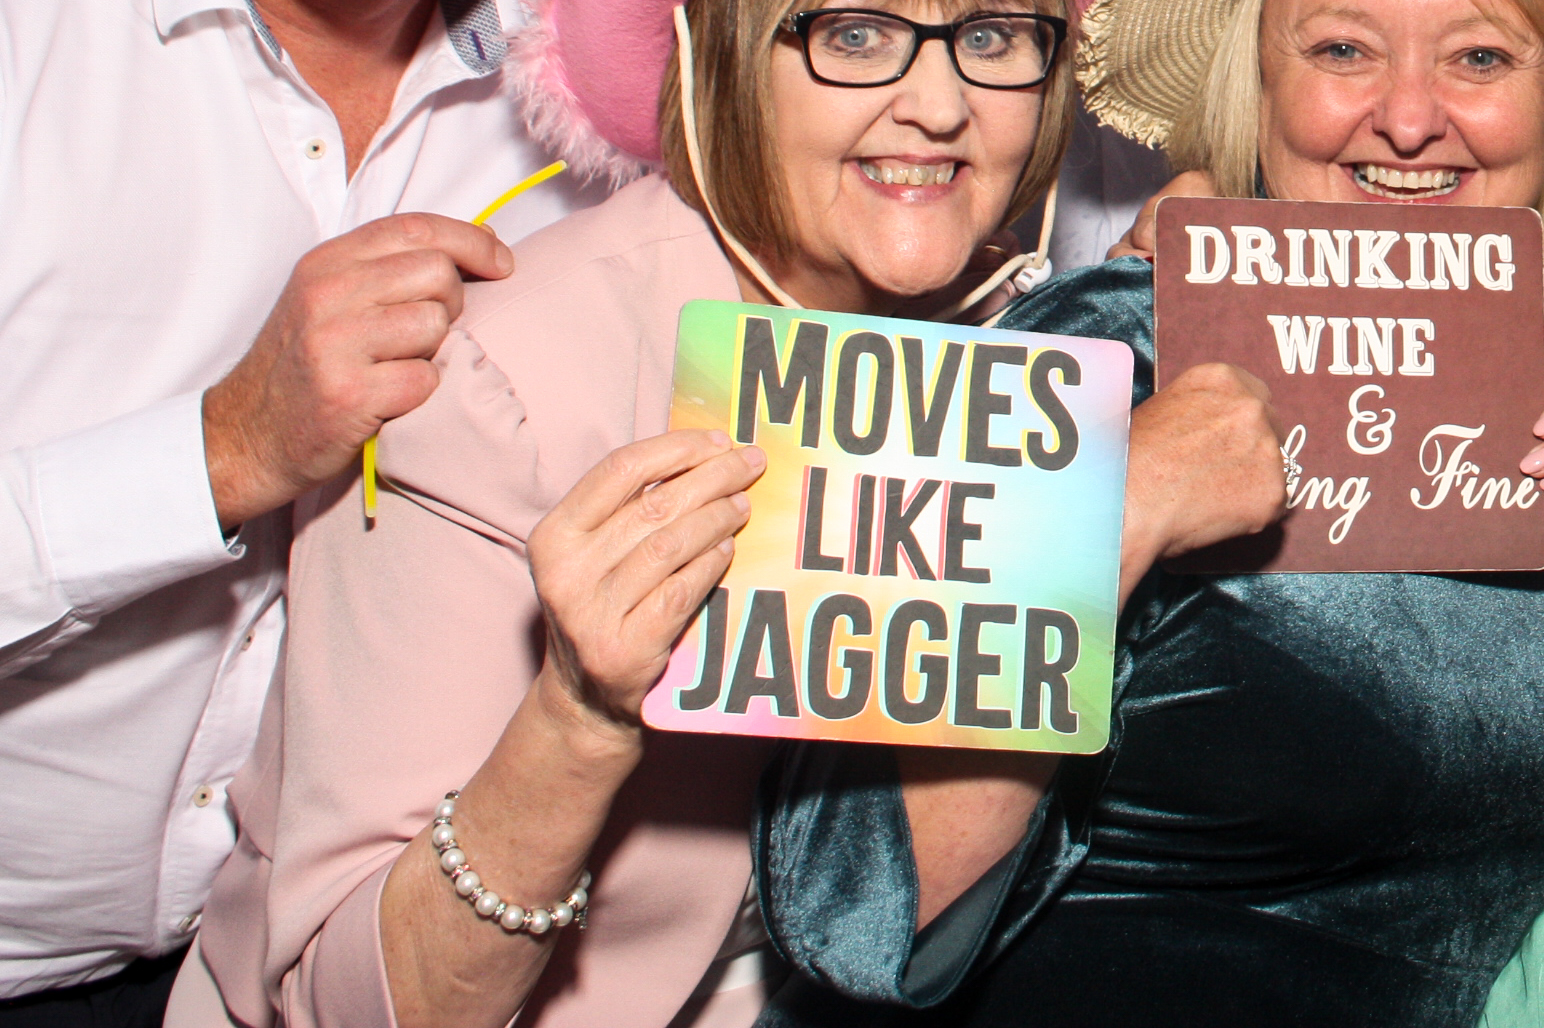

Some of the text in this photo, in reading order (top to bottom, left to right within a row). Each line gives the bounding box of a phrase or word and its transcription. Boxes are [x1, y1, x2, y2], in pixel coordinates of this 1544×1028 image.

[1185, 225, 1516, 291] DRINKING
[1267, 314, 1435, 377] WINE
[730, 313, 1082, 471] MOVES
[1347, 384, 1396, 455] &
[1410, 424, 1540, 510] Fine
[794, 465, 996, 584] LIKE
[672, 585, 1081, 736] JAGGER
